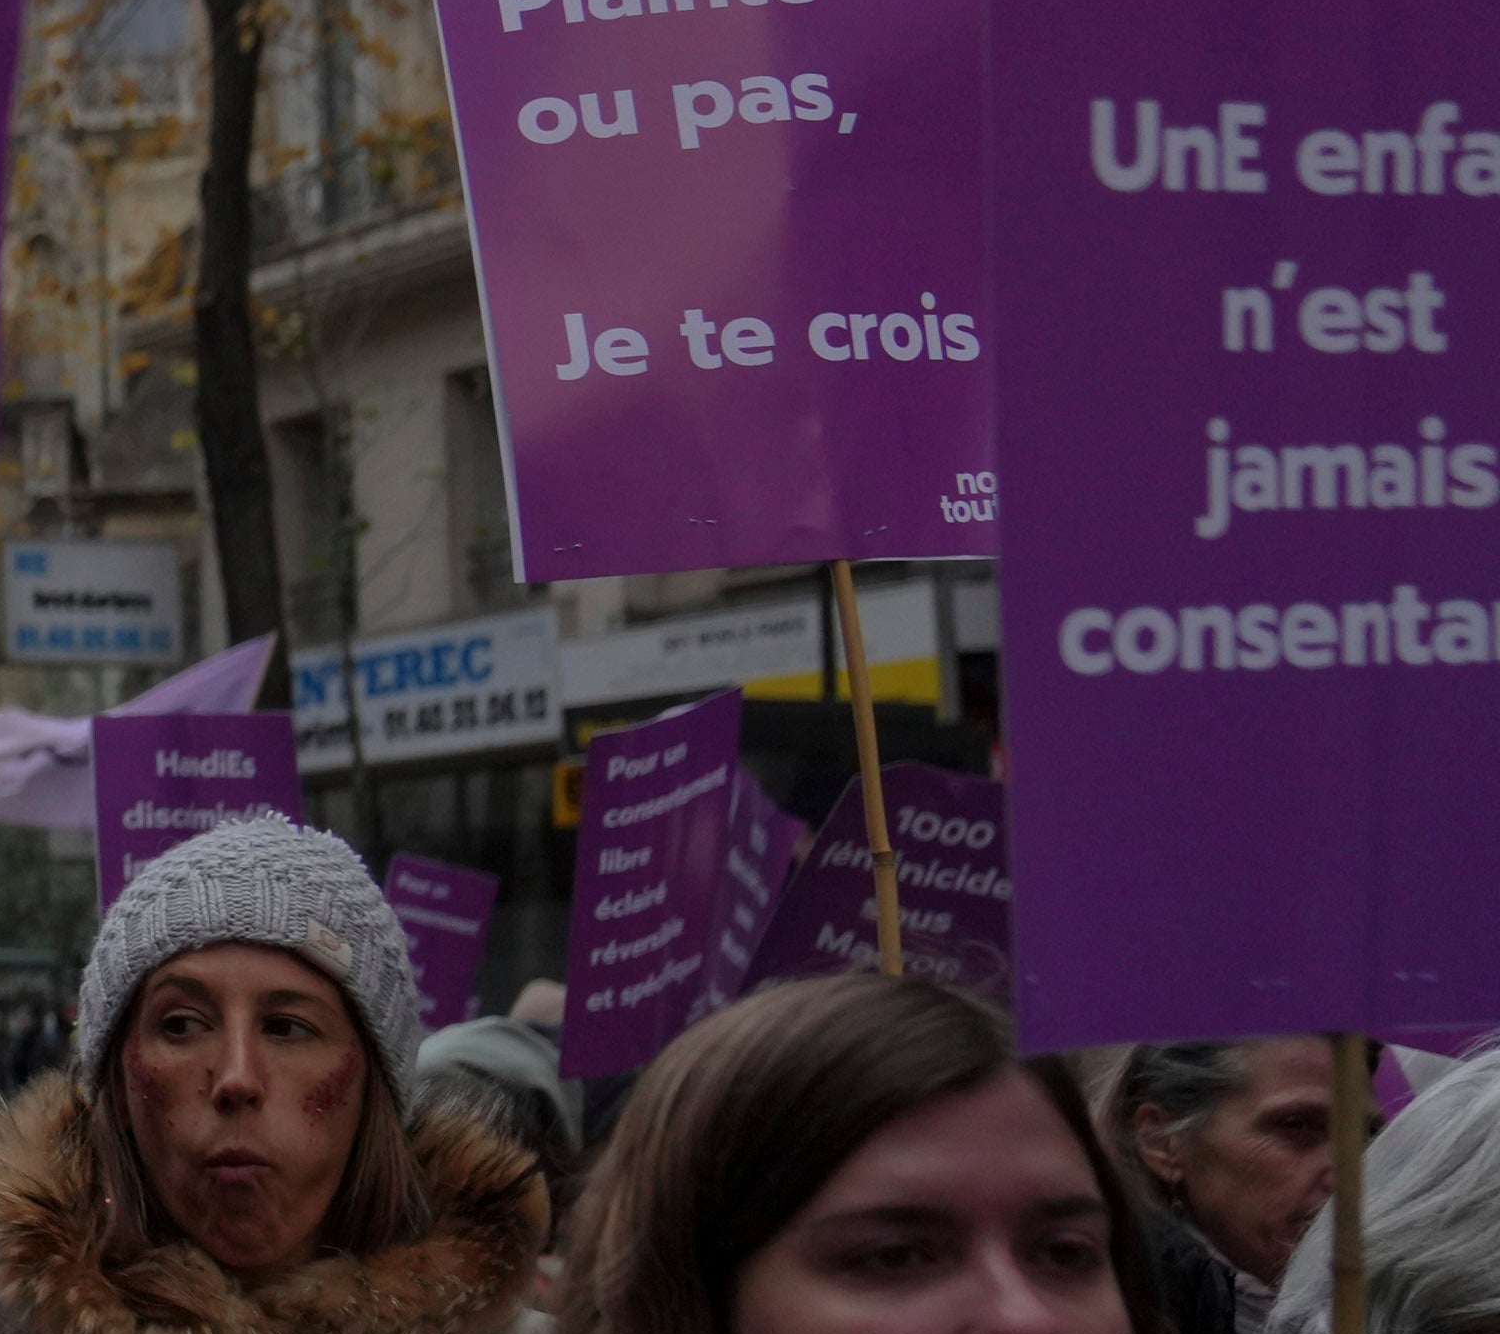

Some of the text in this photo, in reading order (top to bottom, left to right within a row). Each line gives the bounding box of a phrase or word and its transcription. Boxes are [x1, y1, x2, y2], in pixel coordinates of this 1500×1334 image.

[516, 70, 859, 150] ou pas,
[1089, 99, 1500, 197] UnE enfa
[555, 292, 979, 381] Je te crois
[1221, 260, 1448, 354] n'est
[940, 495, 997, 523] tou
[955, 471, 997, 495] no
[1194, 415, 1500, 539] jamais
[1058, 582, 1500, 677] consenta
[897, 804, 996, 850] 1000
